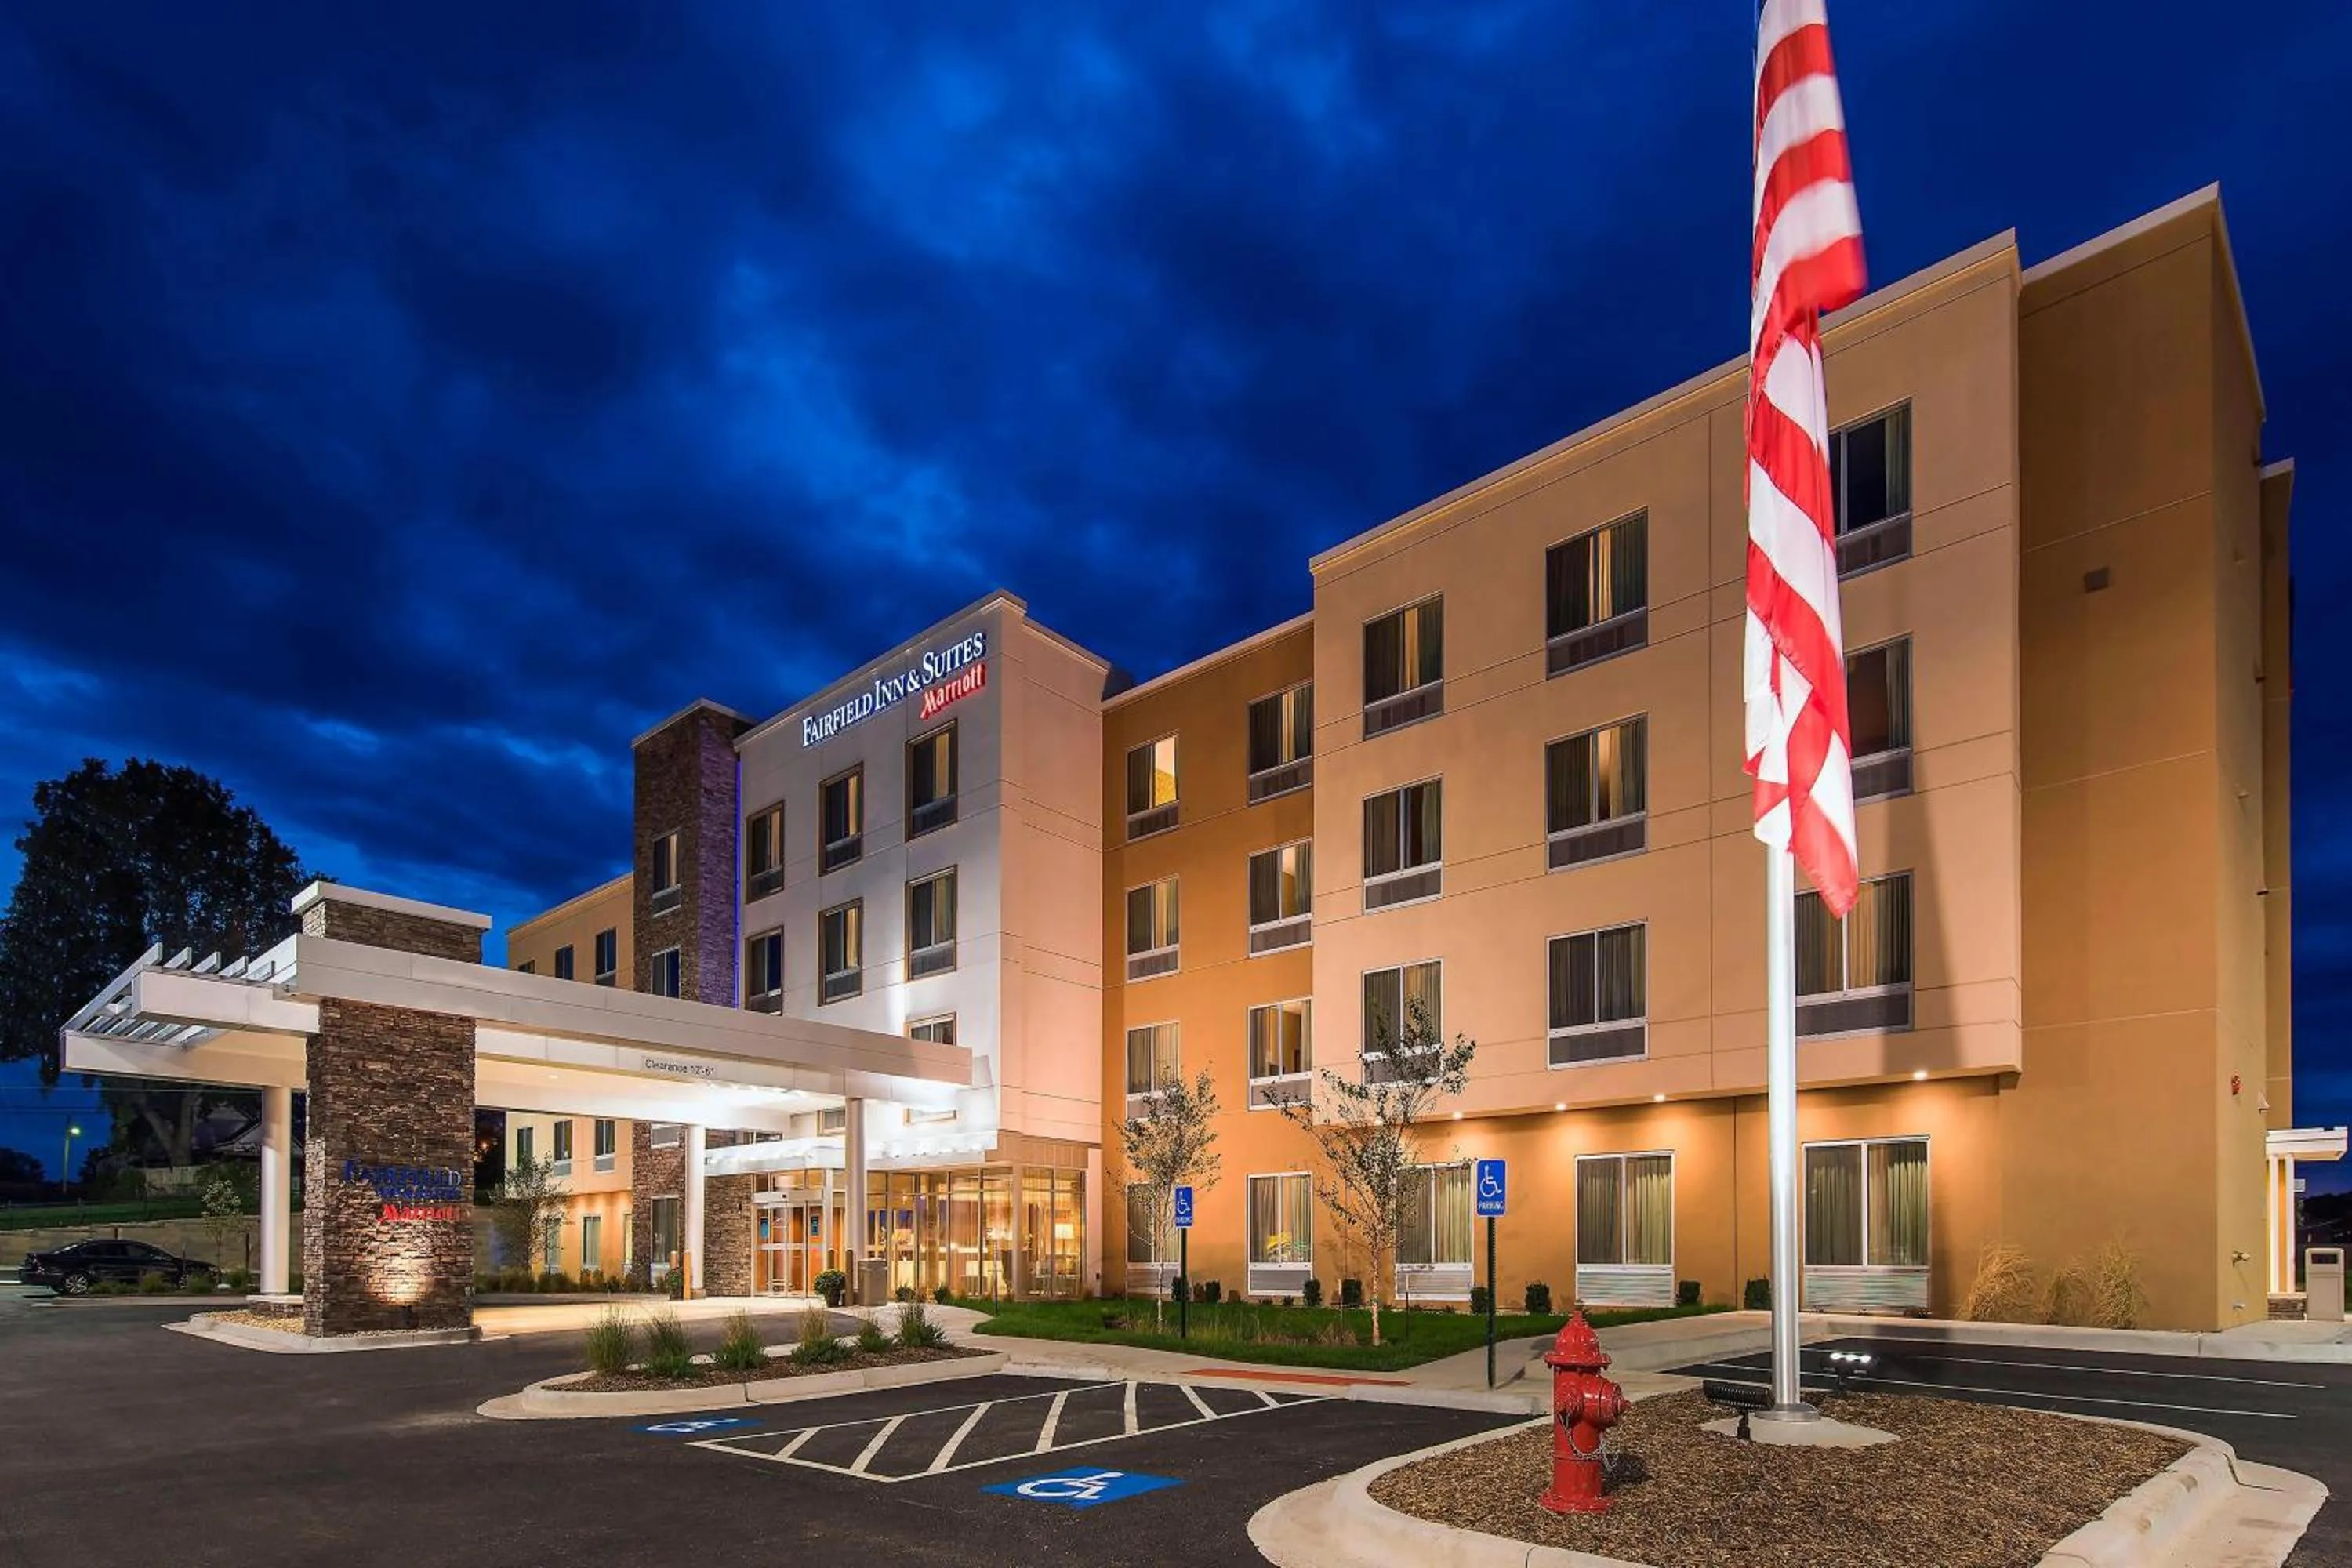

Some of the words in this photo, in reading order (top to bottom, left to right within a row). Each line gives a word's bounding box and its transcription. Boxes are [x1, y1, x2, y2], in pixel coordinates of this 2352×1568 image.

[802, 692, 873, 748] FAIRFIELD
[874, 674, 906, 712] INN
[922, 632, 985, 684] SUITES
[920, 662, 985, 720] Marriott
[645, 1058, 688, 1073] Clearance
